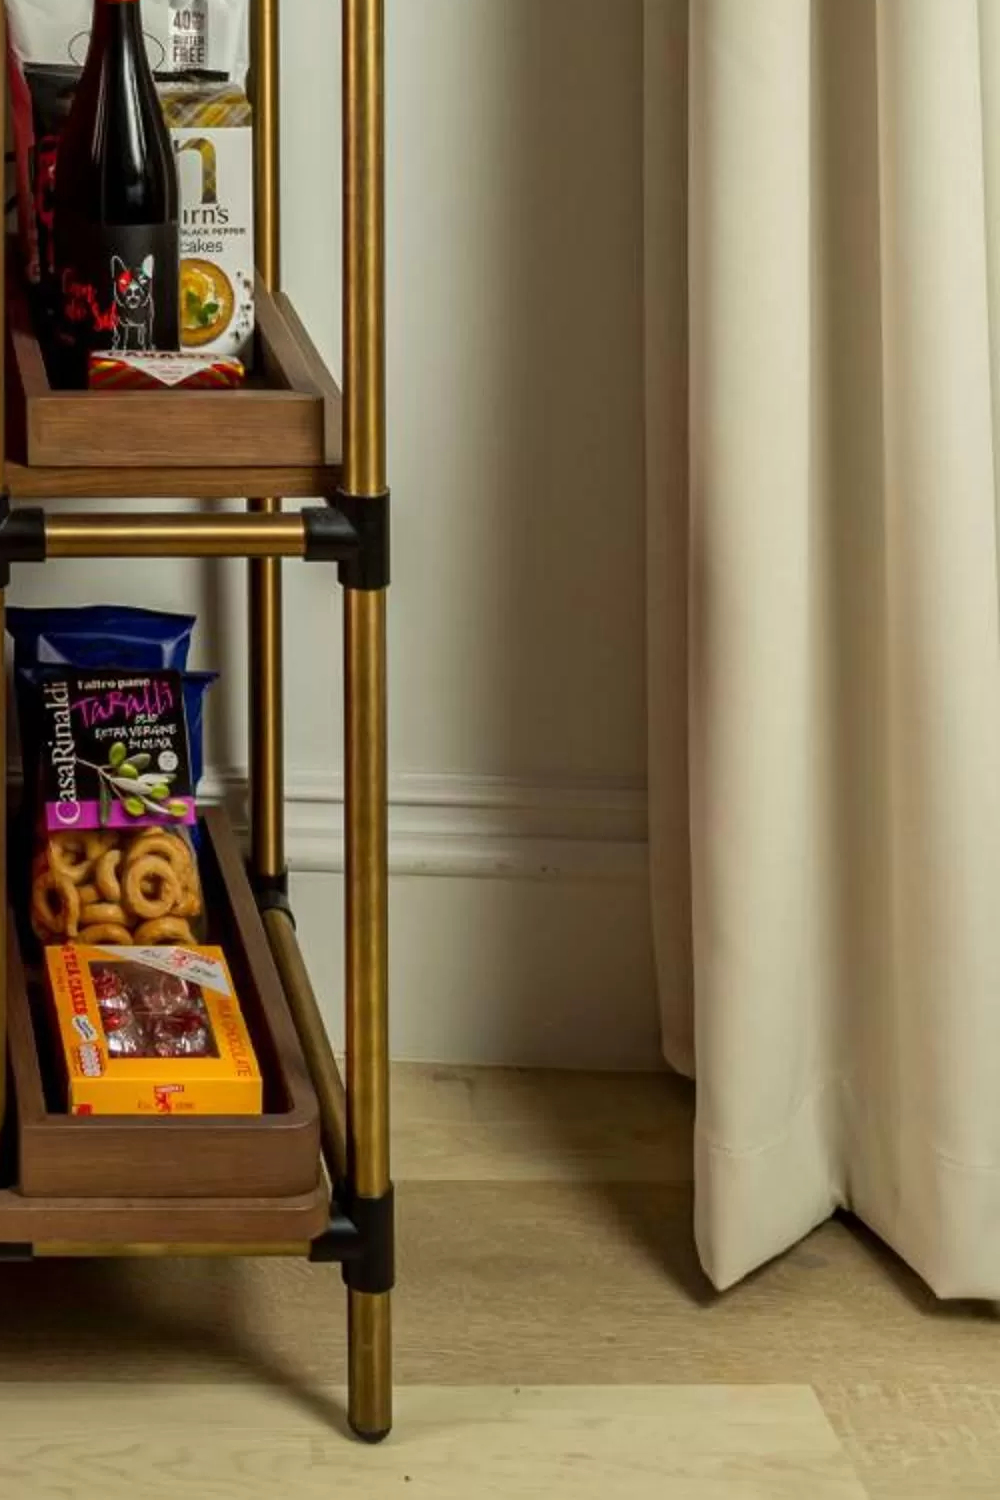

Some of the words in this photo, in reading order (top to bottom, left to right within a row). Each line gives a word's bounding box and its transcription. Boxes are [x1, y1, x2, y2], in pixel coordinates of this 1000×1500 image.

[173, 47, 205, 63] FREE
[183, 205, 229, 225] irn's
[179, 238, 223, 253] cakes
